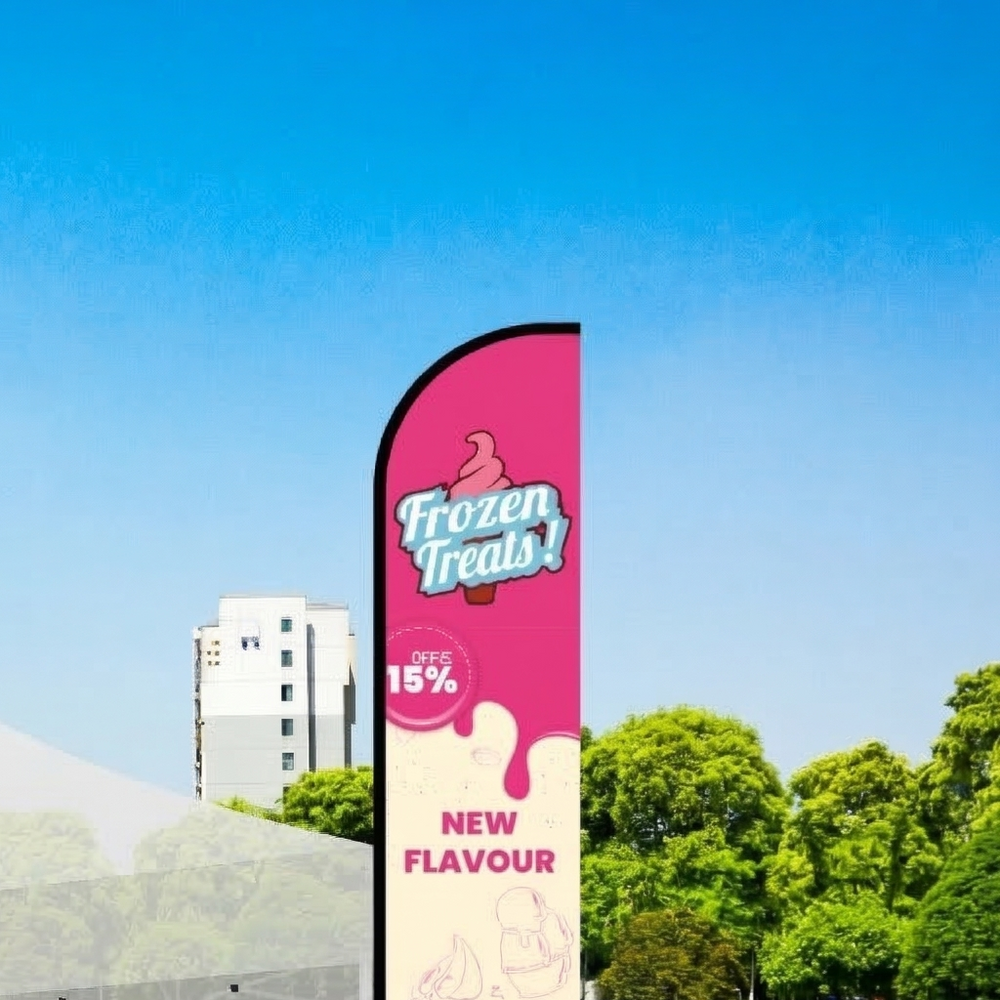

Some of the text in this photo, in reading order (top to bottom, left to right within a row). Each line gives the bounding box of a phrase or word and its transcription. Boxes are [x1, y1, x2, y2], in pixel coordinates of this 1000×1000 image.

[400, 487, 549, 543] Frozen
[386, 665, 458, 694] 15%
[442, 811, 517, 835] NEW
[405, 850, 555, 873] FLAVOUR
